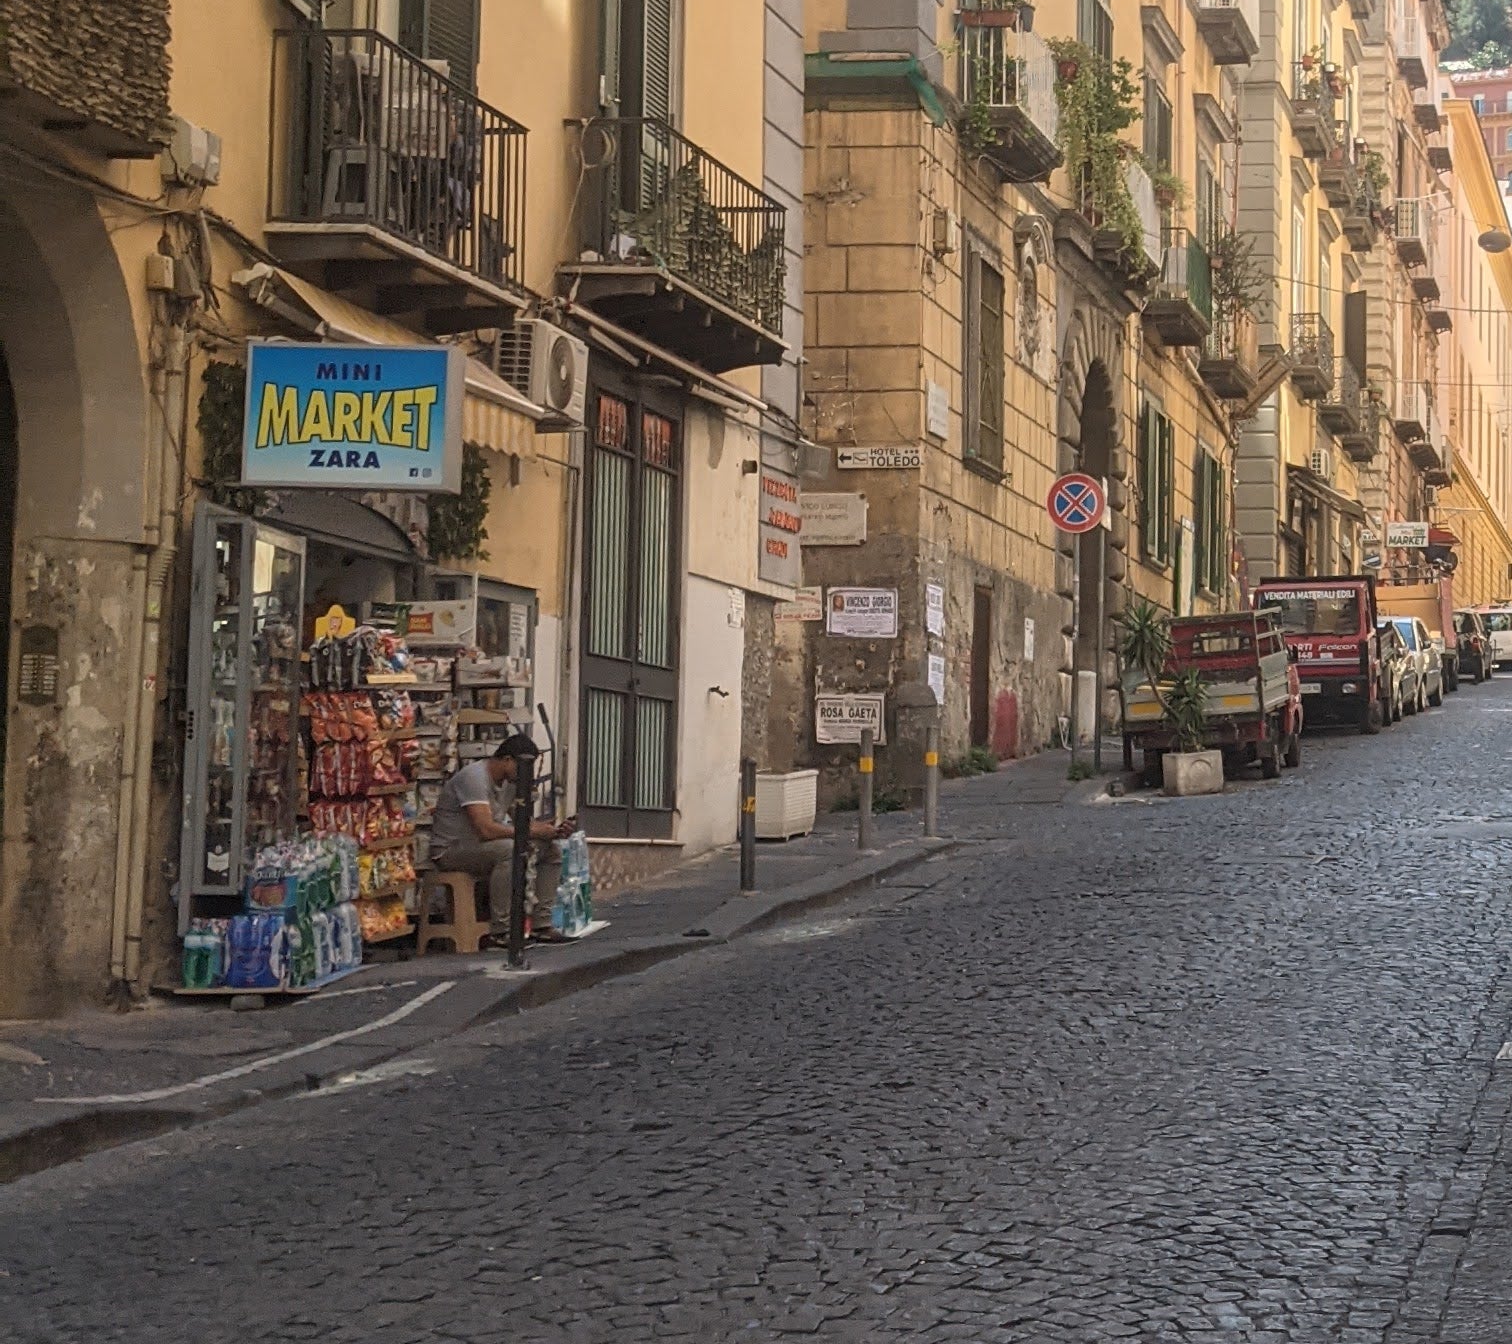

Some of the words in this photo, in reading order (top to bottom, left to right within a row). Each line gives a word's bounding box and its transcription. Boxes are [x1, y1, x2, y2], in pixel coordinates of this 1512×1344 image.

[316, 362, 383, 381] MINI
[256, 381, 438, 452] MARKET
[870, 448, 901, 456] HOTEL
[308, 449, 381, 469] ZARA
[869, 456, 920, 467] TOLEDO
[1388, 535, 1427, 546] MARKET
[1264, 591, 1295, 601] VENDITA
[1296, 590, 1335, 600] MATERIALI
[820, 707, 844, 718] ROSA
[848, 707, 877, 719] GAETA
